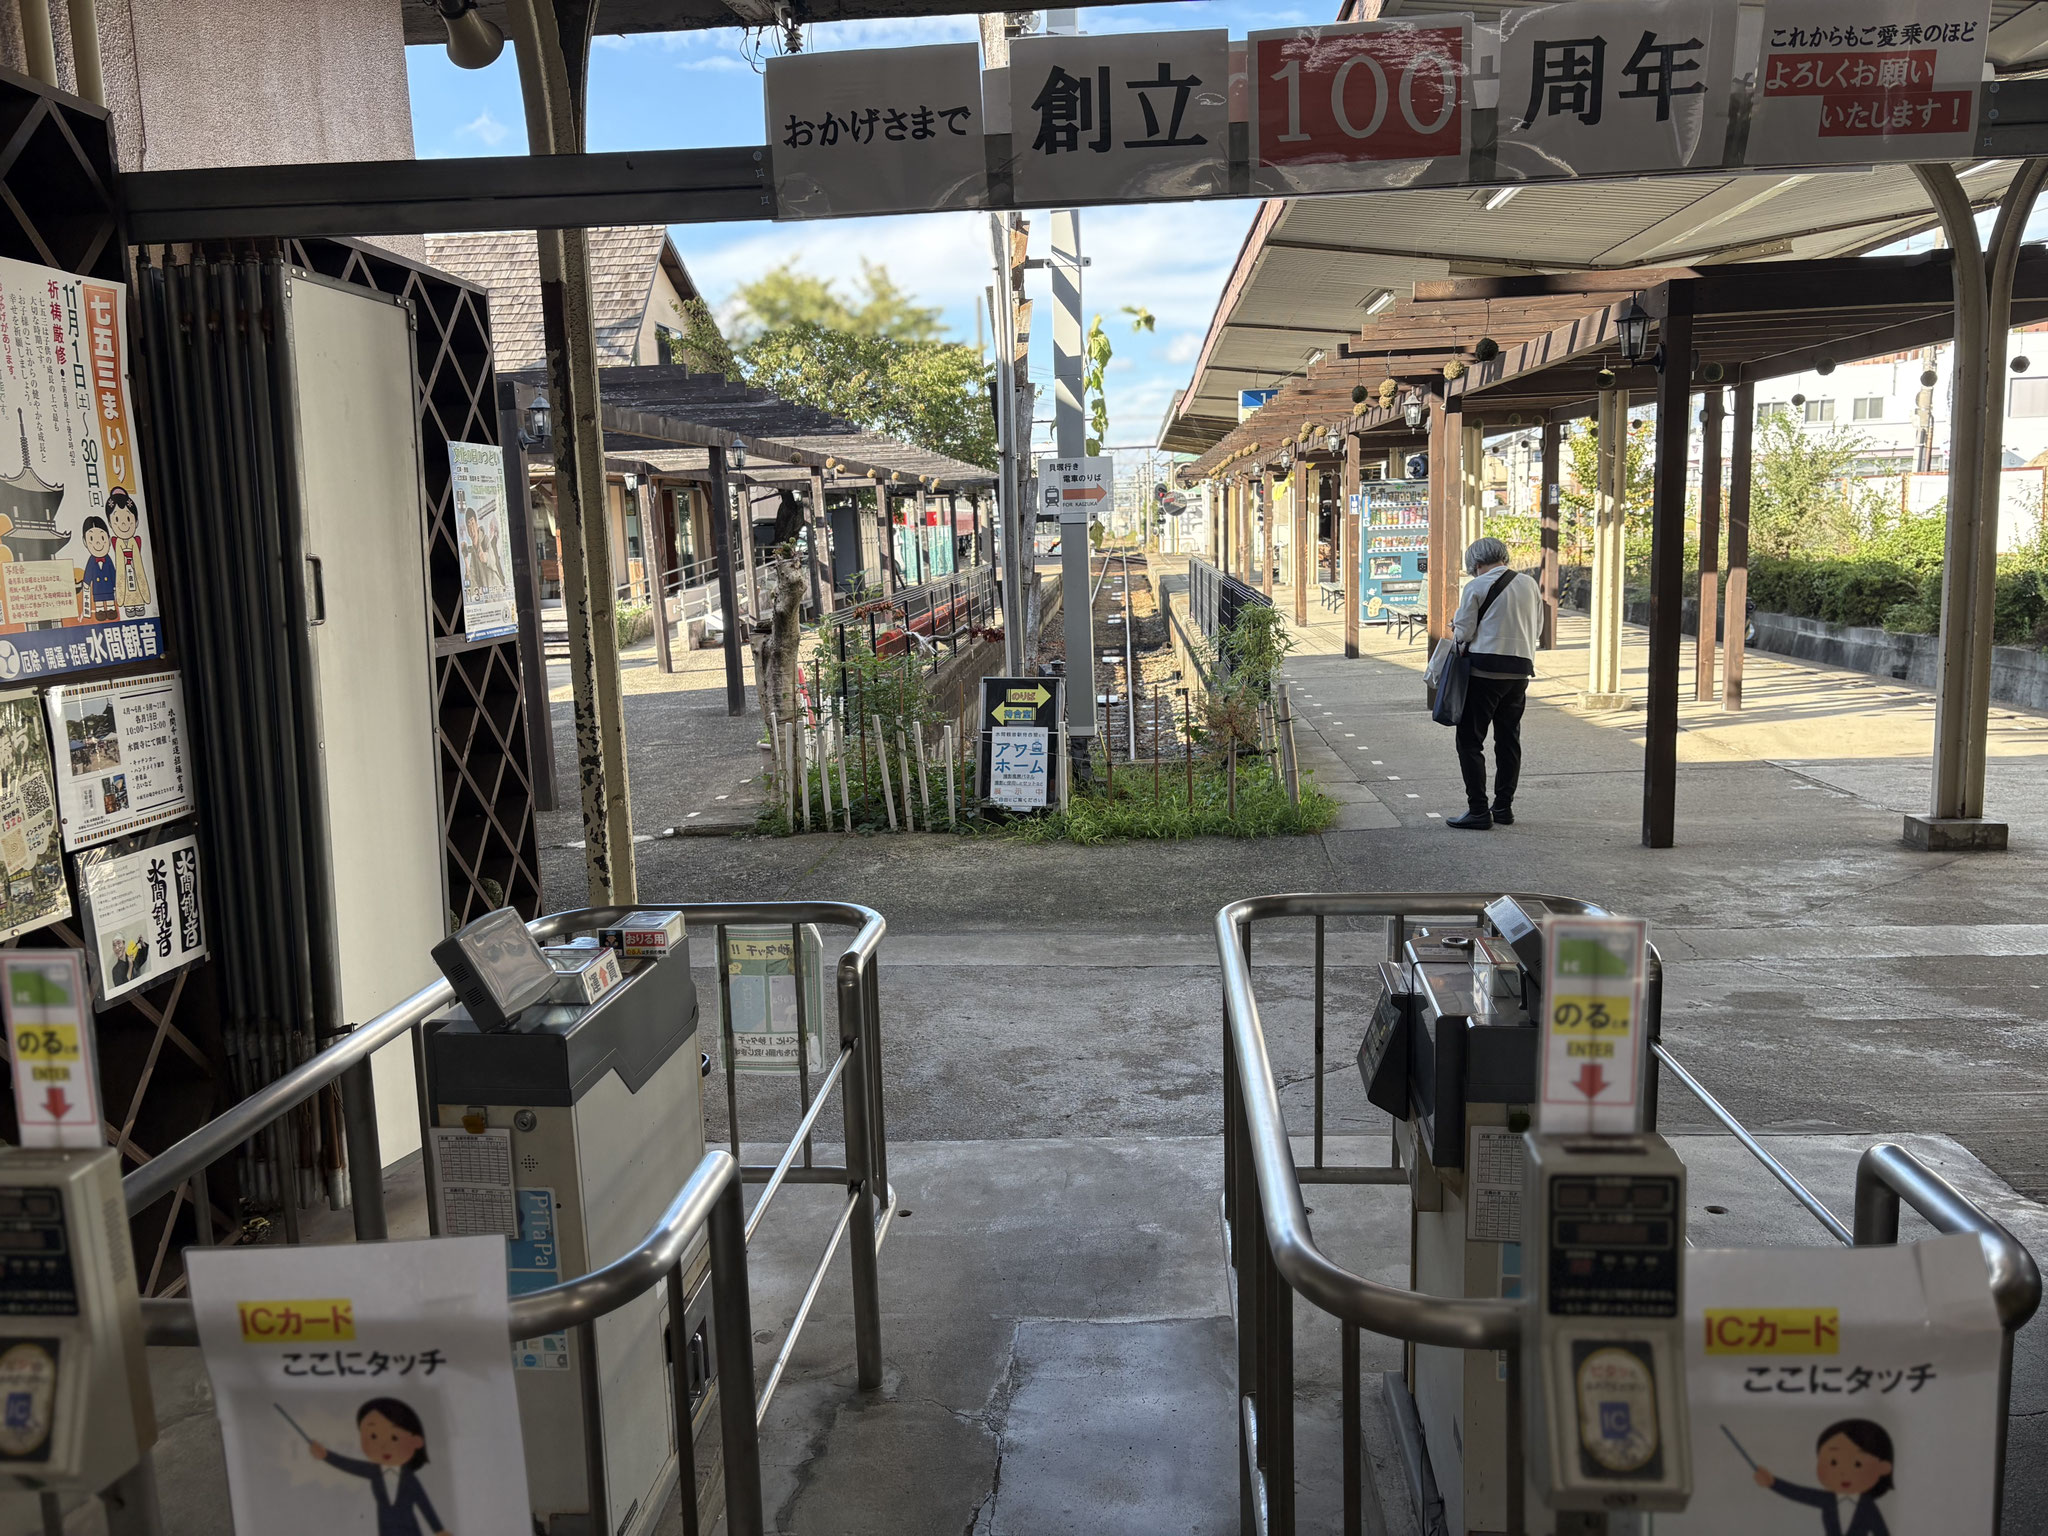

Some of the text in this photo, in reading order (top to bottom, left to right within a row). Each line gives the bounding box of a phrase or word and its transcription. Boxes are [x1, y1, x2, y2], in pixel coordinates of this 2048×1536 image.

[1770, 20, 1978, 49] これからもご愛乗のほど
[1521, 29, 1708, 130] 周年
[1764, 53, 1934, 90] よろしくお願い
[1031, 62, 1209, 156] 創立
[1270, 52, 1456, 143] 100
[783, 105, 971, 149] おかげさまで
[90, 294, 126, 483] 七五三まいり
[1049, 463, 1079, 472] 貝塚行き
[1063, 474, 1102, 483] 電車のりば
[85, 623, 158, 665] 水間観音
[1011, 691, 1036, 701] のりば
[1003, 709, 1033, 719] 待合室
[994, 758, 1044, 774] ホーム
[146, 858, 173, 958] 水間観音
[176, 850, 200, 948] 水間観音
[626, 933, 665, 945] おりる用
[1567, 1041, 1614, 1058] ENTER
[239, 1303, 354, 1337] ICカード
[1704, 1314, 1838, 1349] ICカード
[282, 1348, 447, 1377] ここにタッチ
[1743, 1363, 1937, 1395] ここにタッチ
[1604, 1409, 1629, 1433] IC
